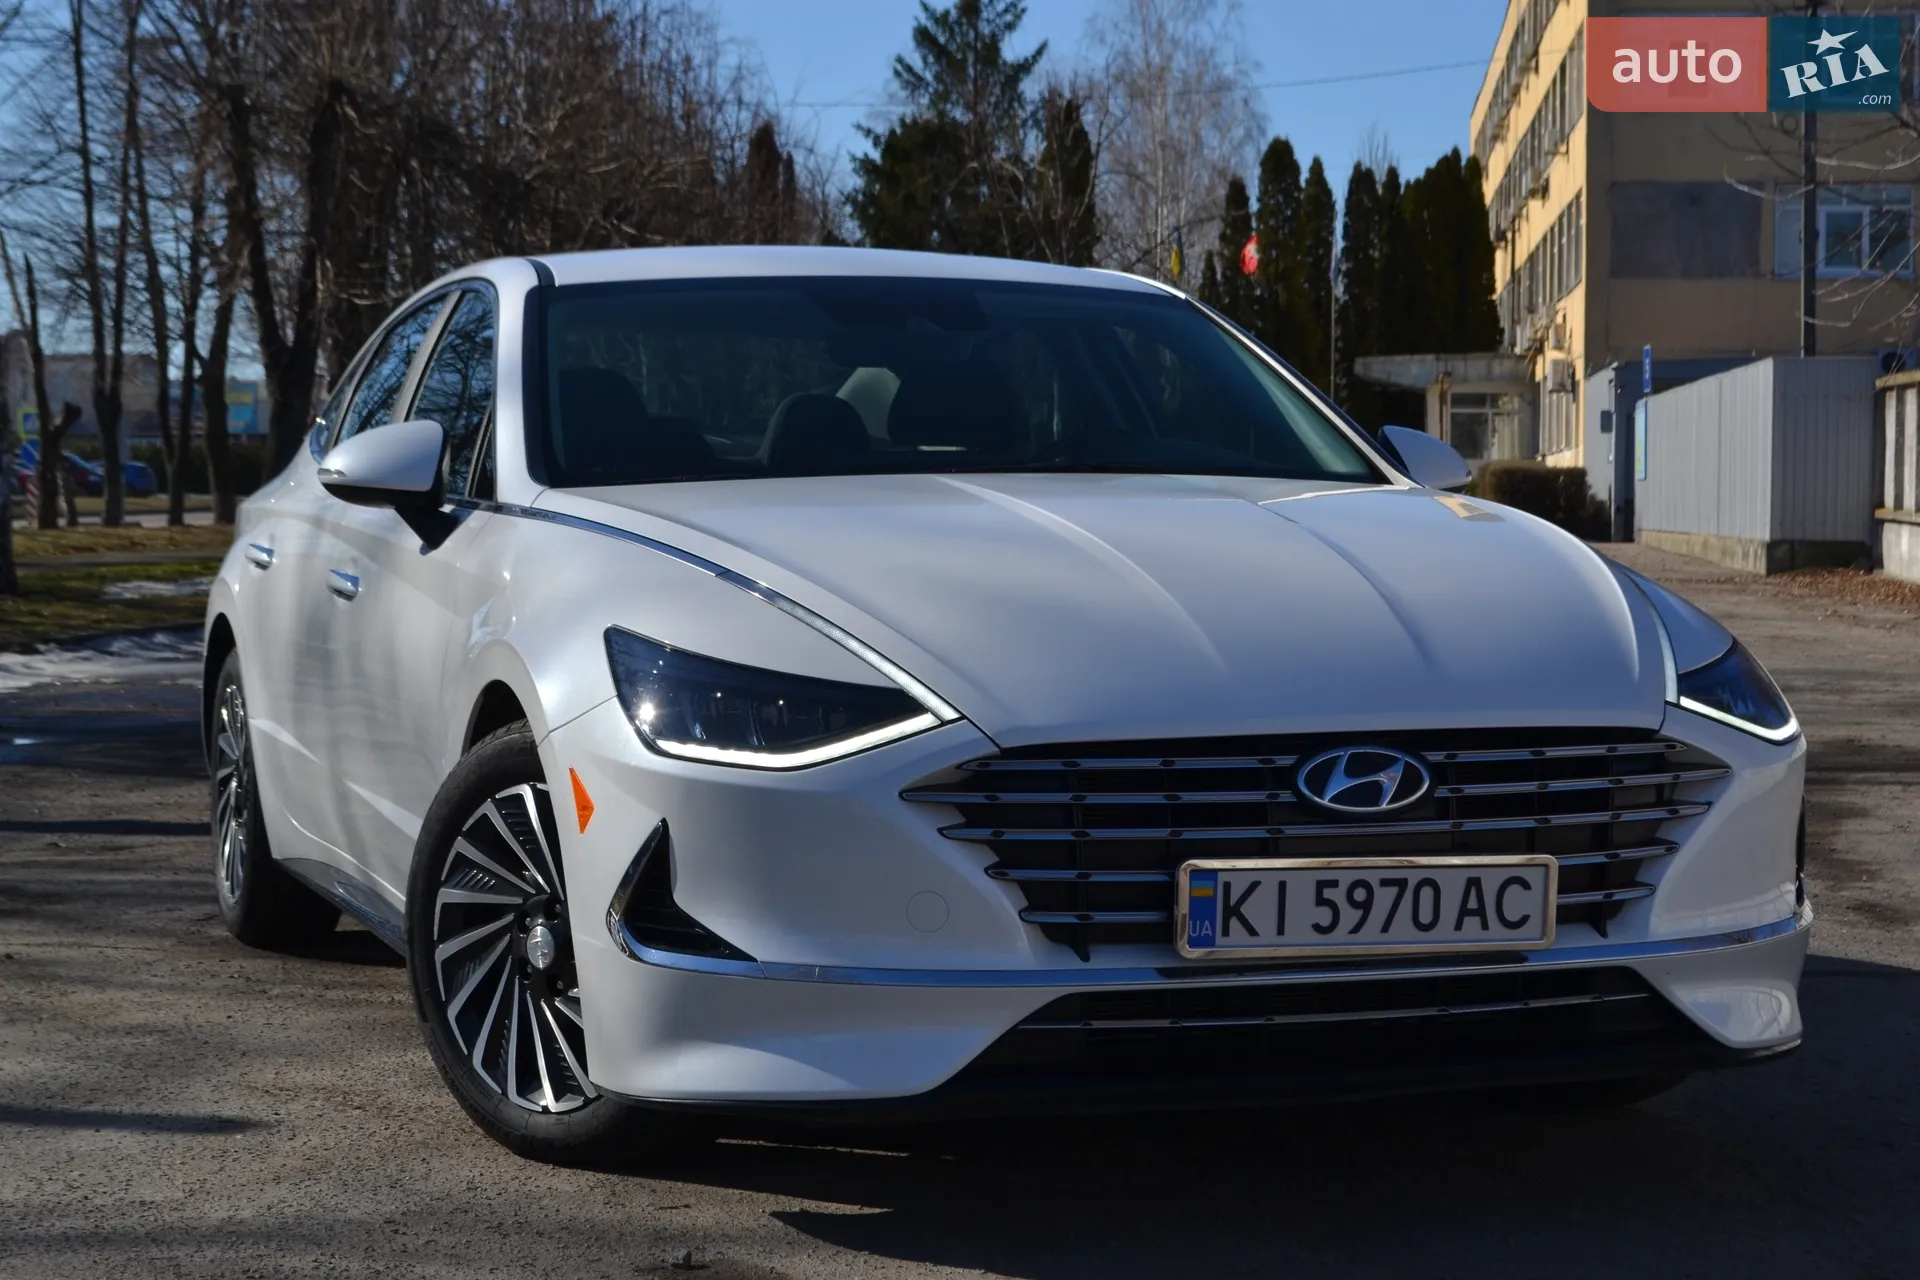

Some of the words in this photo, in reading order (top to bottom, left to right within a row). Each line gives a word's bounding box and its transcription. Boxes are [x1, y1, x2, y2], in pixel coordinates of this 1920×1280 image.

[1221, 880, 1287, 937] KI
[1311, 876, 1441, 935] 5970
[1454, 875, 1533, 932] AC
[1188, 919, 1213, 938] UA
